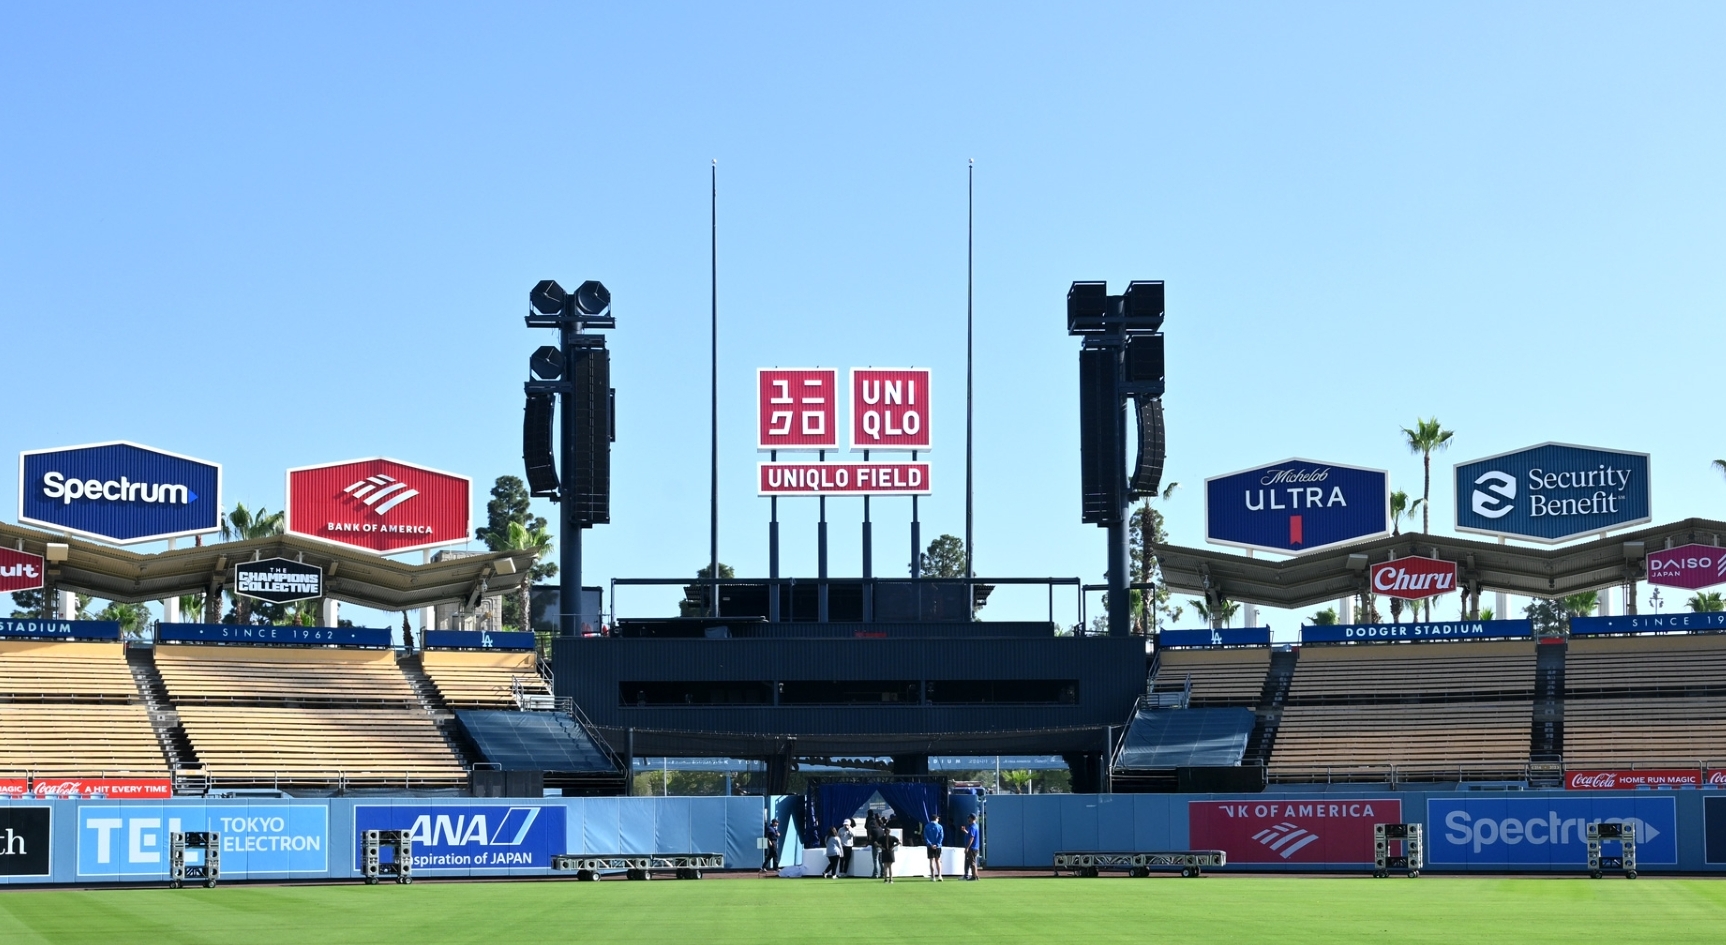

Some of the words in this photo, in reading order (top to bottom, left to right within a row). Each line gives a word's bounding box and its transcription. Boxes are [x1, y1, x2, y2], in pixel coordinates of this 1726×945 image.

[863, 380, 915, 405] UNI
[863, 410, 920, 440] QLO
[769, 468, 849, 490] UNIQLO
[857, 468, 921, 487] FIELD
[1260, 467, 1331, 485] Michelob
[1529, 464, 1632, 491] Security
[44, 471, 188, 504] Spectrum
[1246, 486, 1346, 510] ULTRA
[1530, 491, 1619, 516] Benefit
[328, 522, 360, 532] BANK
[362, 523, 377, 533] OF
[380, 524, 433, 534] AMERICA
[1651, 557, 1711, 570] DAISO
[239, 572, 319, 583] CHAMPIONS
[1374, 567, 1453, 590] Churu
[1651, 570, 1681, 578] JAPAN
[239, 581, 319, 593] COLLECTIVE
[0, 621, 71, 633] STADIUM
[1632, 616, 1690, 627] SINCE
[223, 627, 278, 639] SINCE
[293, 629, 334, 640] 1962
[1345, 625, 1408, 637] DODGER
[1414, 623, 1484, 635] STADIUM
[1620, 776, 1645, 784] HOME
[1647, 776, 1666, 784] RUN
[84, 785, 92, 793] A
[93, 785, 109, 793] HIT
[112, 785, 142, 793] EVERY
[144, 785, 168, 793] TIME
[1255, 805, 1279, 818] OF
[1284, 804, 1375, 818] AMERICA
[221, 817, 285, 833] TOKYO
[411, 815, 489, 846] ANA
[223, 836, 321, 852] ELECTRON
[474, 851, 489, 865] of
[490, 852, 533, 865] JAPAN
